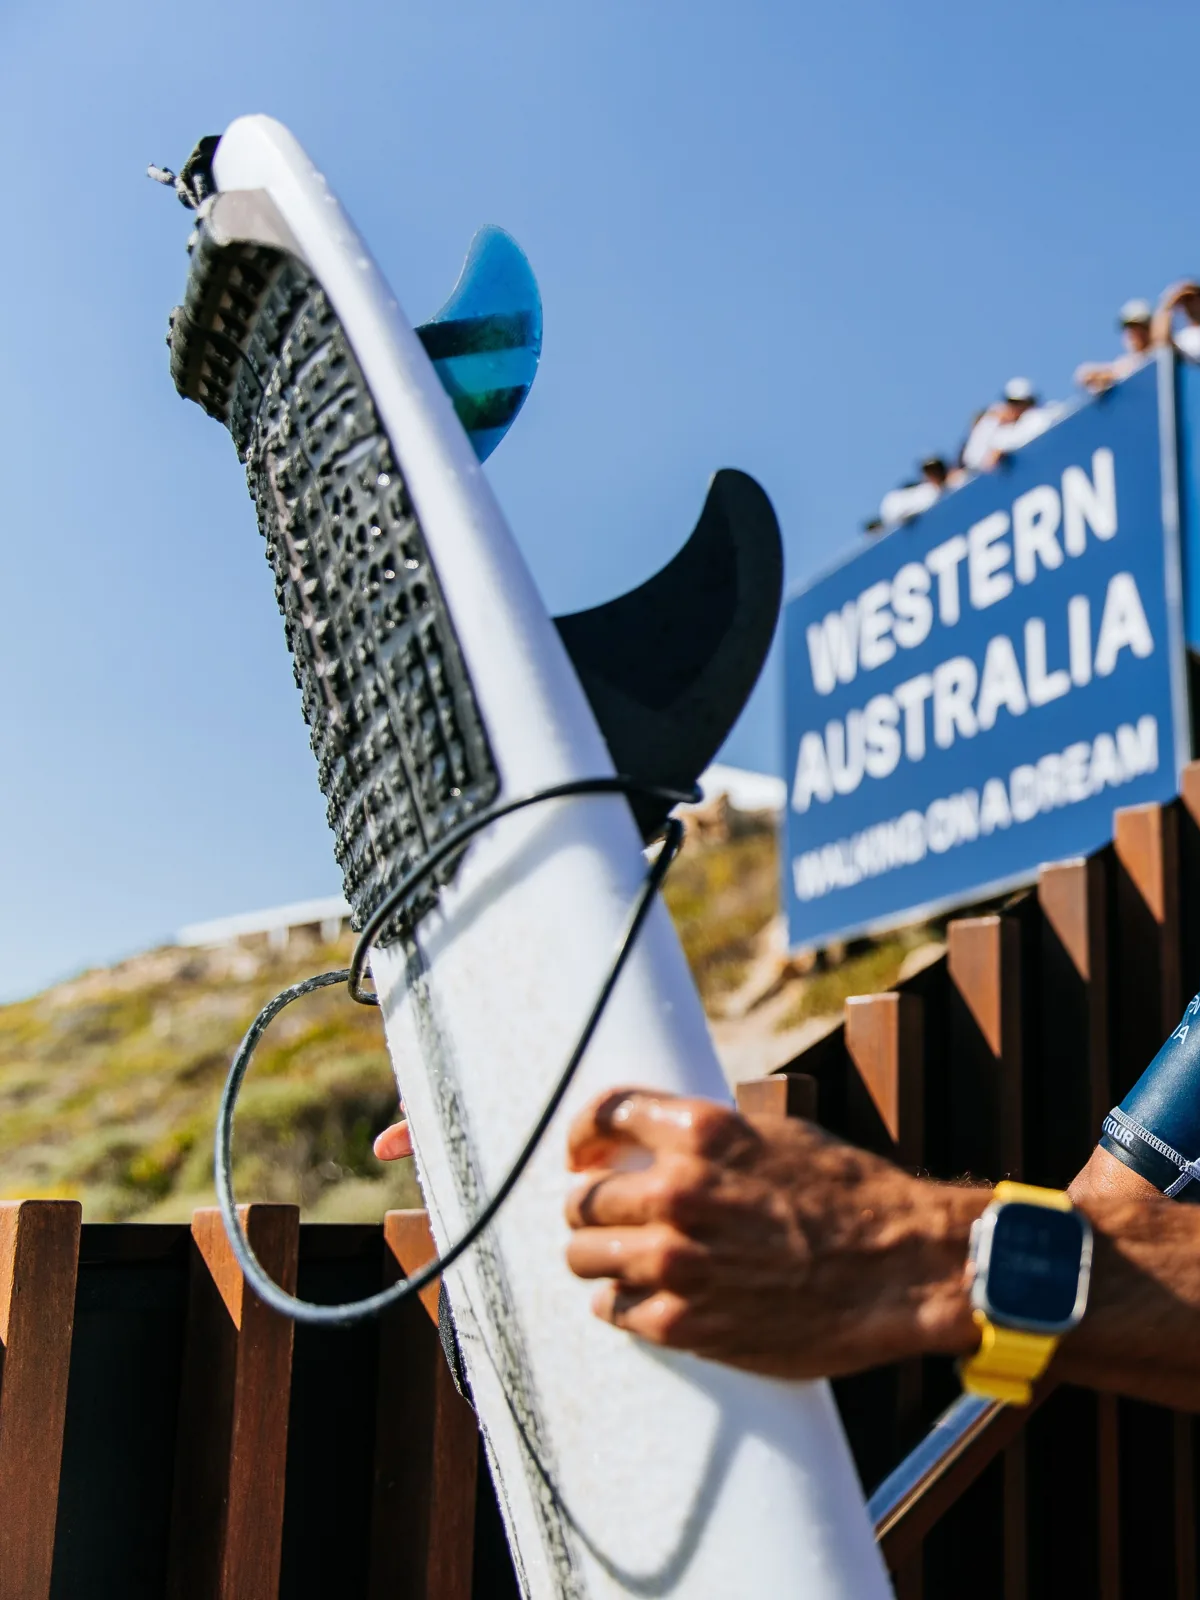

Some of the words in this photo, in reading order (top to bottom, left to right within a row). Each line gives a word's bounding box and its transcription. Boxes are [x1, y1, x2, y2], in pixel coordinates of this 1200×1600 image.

[792, 571, 1154, 813] AUSTRALIA
[805, 446, 1118, 696] WESTERN
[925, 787, 980, 854] ON
[980, 777, 1012, 836] A
[1009, 714, 1159, 823] DREAM
